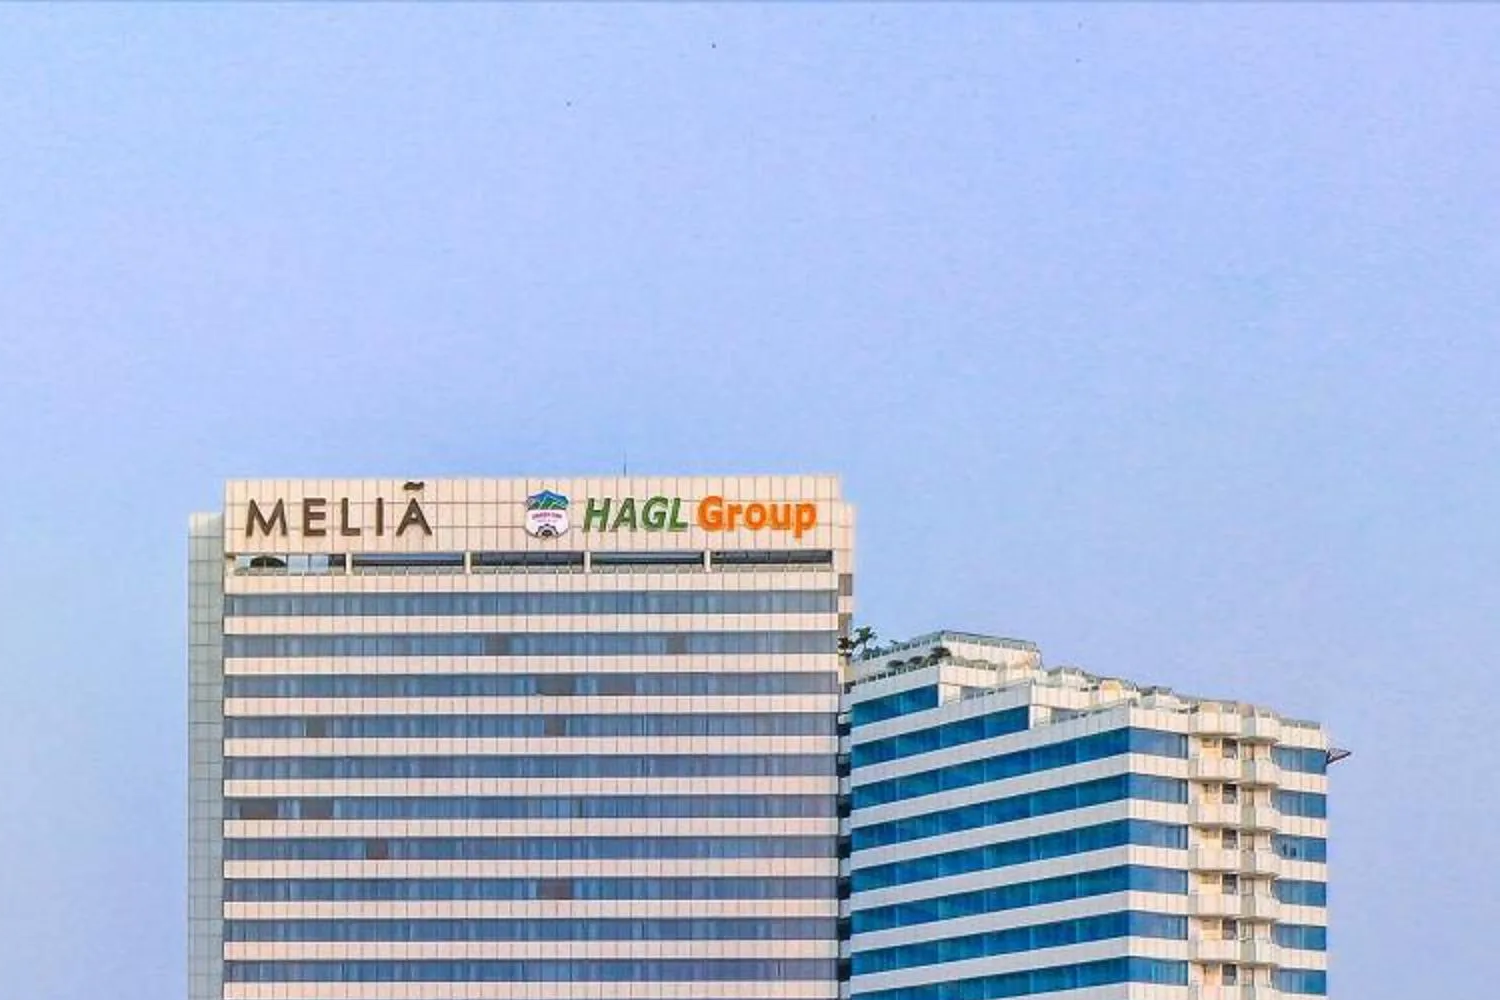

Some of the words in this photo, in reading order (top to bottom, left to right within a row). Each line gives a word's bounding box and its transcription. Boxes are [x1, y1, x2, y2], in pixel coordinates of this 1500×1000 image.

[245, 481, 433, 537] MELIÃ
[581, 496, 689, 533] HAGL
[696, 495, 818, 539] Group
